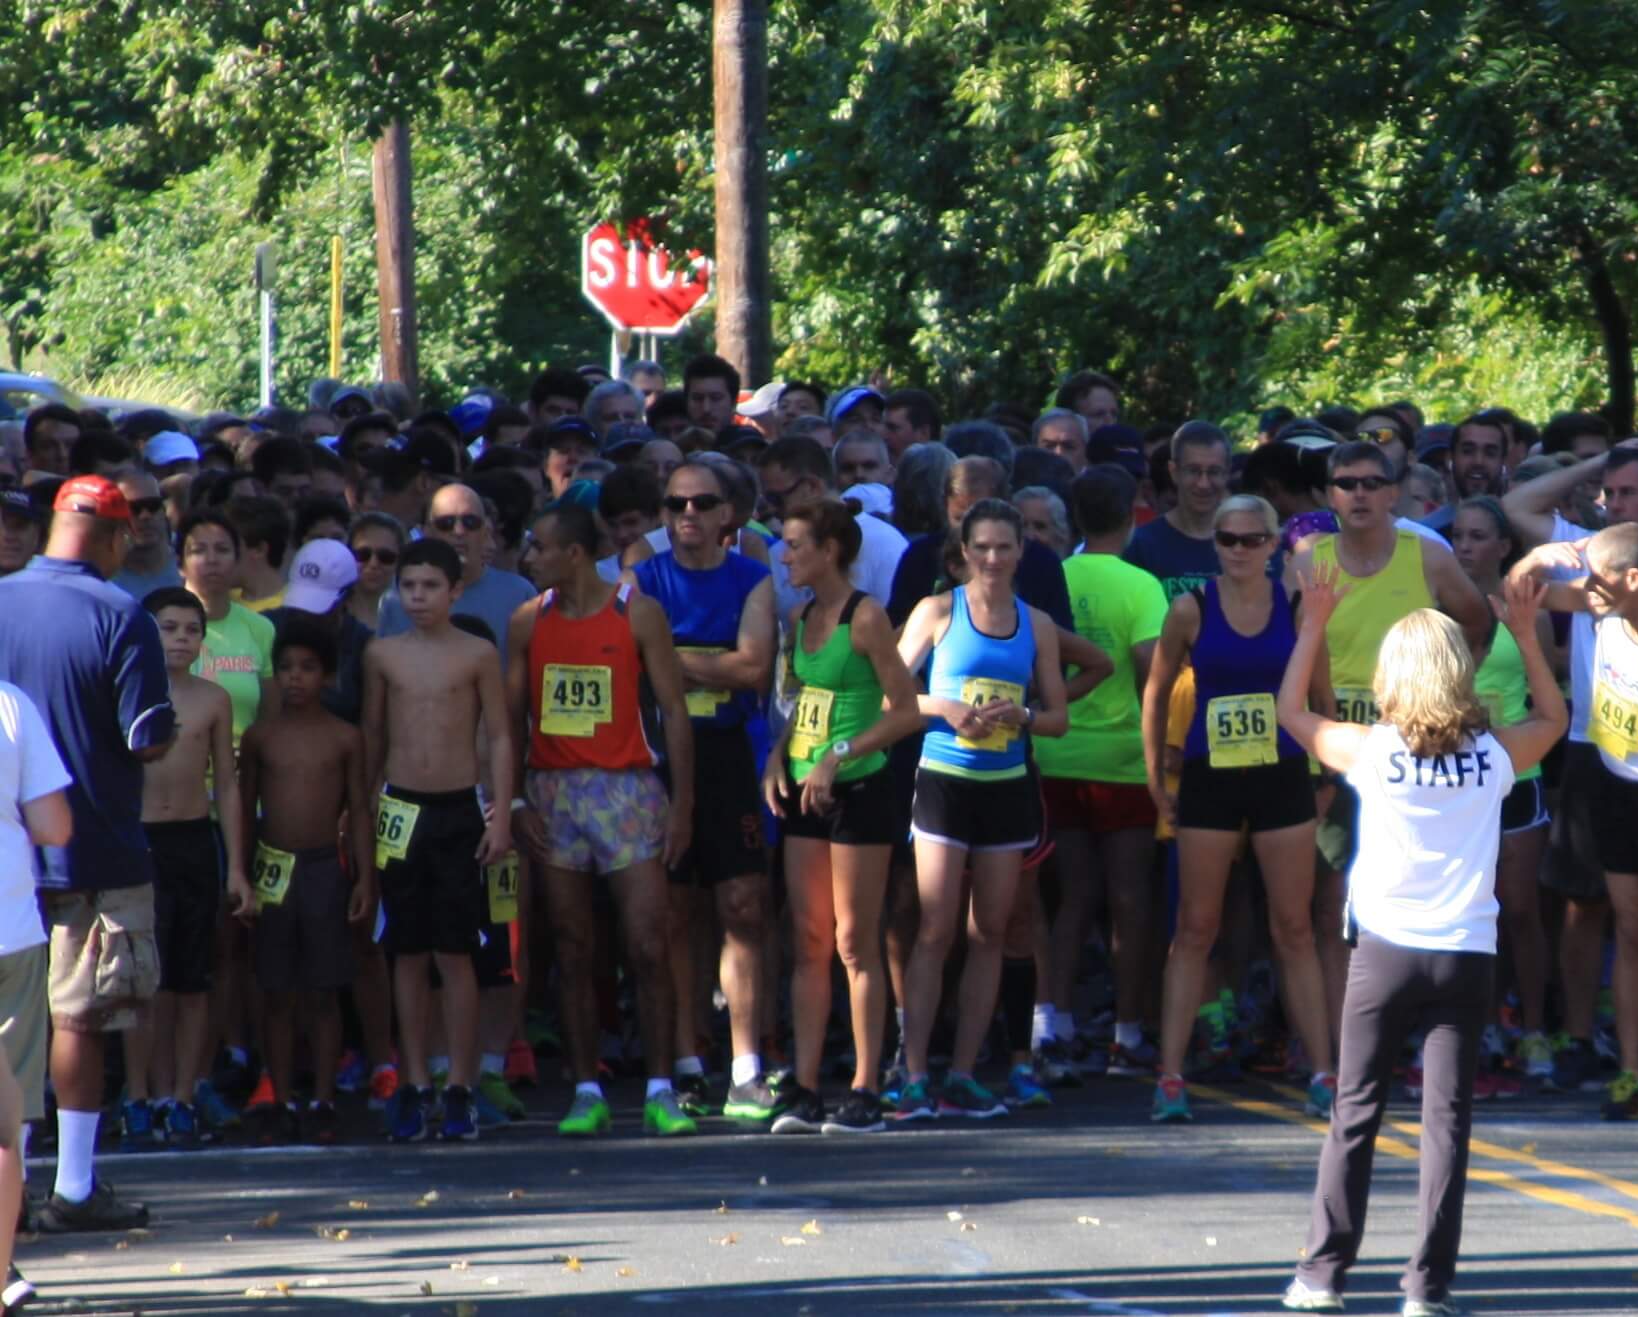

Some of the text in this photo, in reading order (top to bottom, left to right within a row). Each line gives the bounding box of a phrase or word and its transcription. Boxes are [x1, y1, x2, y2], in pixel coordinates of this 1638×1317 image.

[553, 680, 601, 706] 493
[797, 701, 819, 729] 14
[1217, 709, 1266, 737] 536
[1601, 700, 1637, 736] 494
[1387, 750, 1492, 787] STAFF
